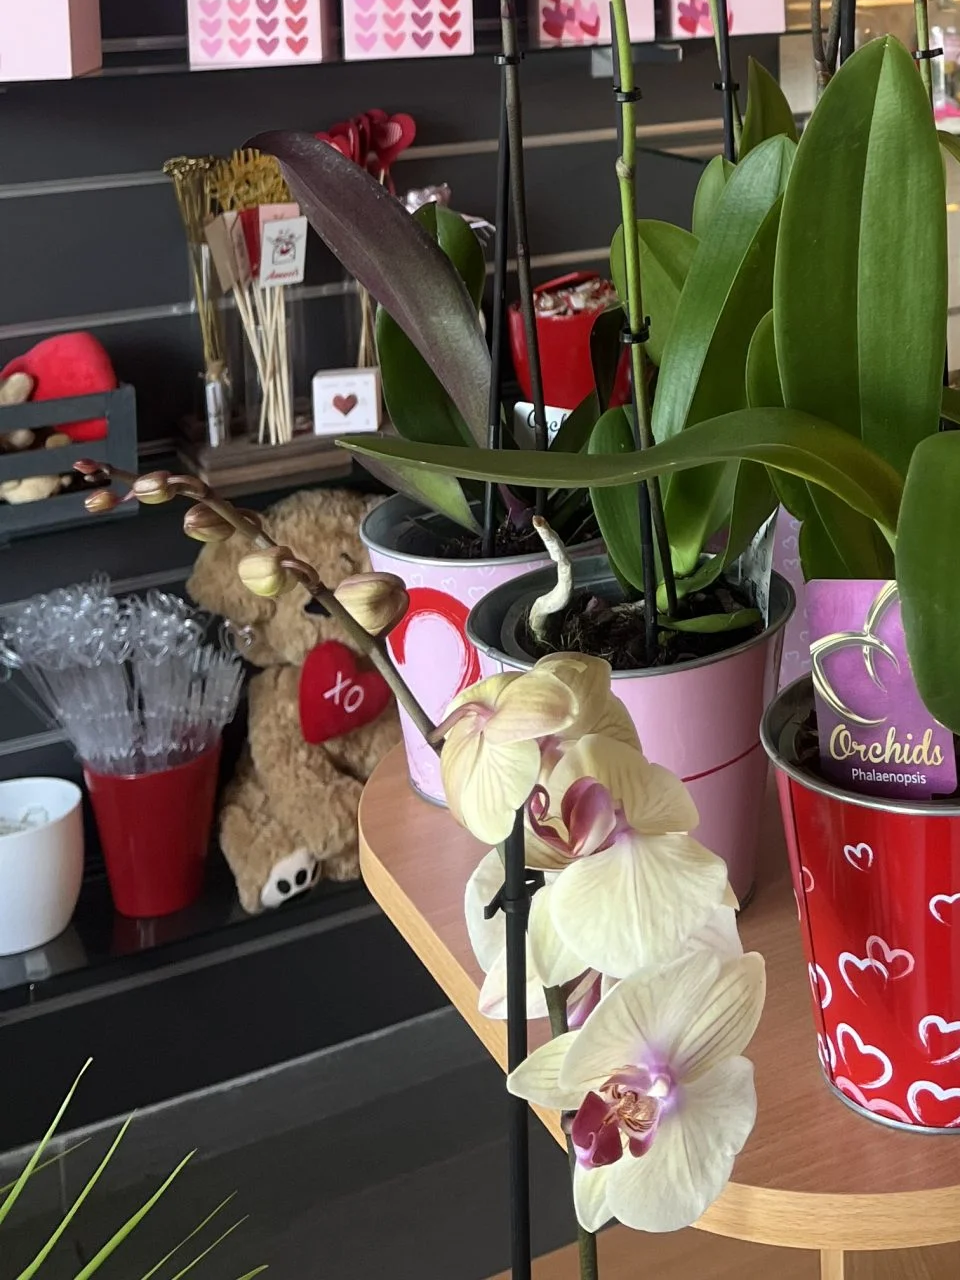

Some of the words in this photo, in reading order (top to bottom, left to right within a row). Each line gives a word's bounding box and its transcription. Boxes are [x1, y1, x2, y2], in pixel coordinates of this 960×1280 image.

[323, 670, 365, 714] XO
[829, 723, 944, 767] Orchids
[851, 767, 927, 787] Phalaenopsis
